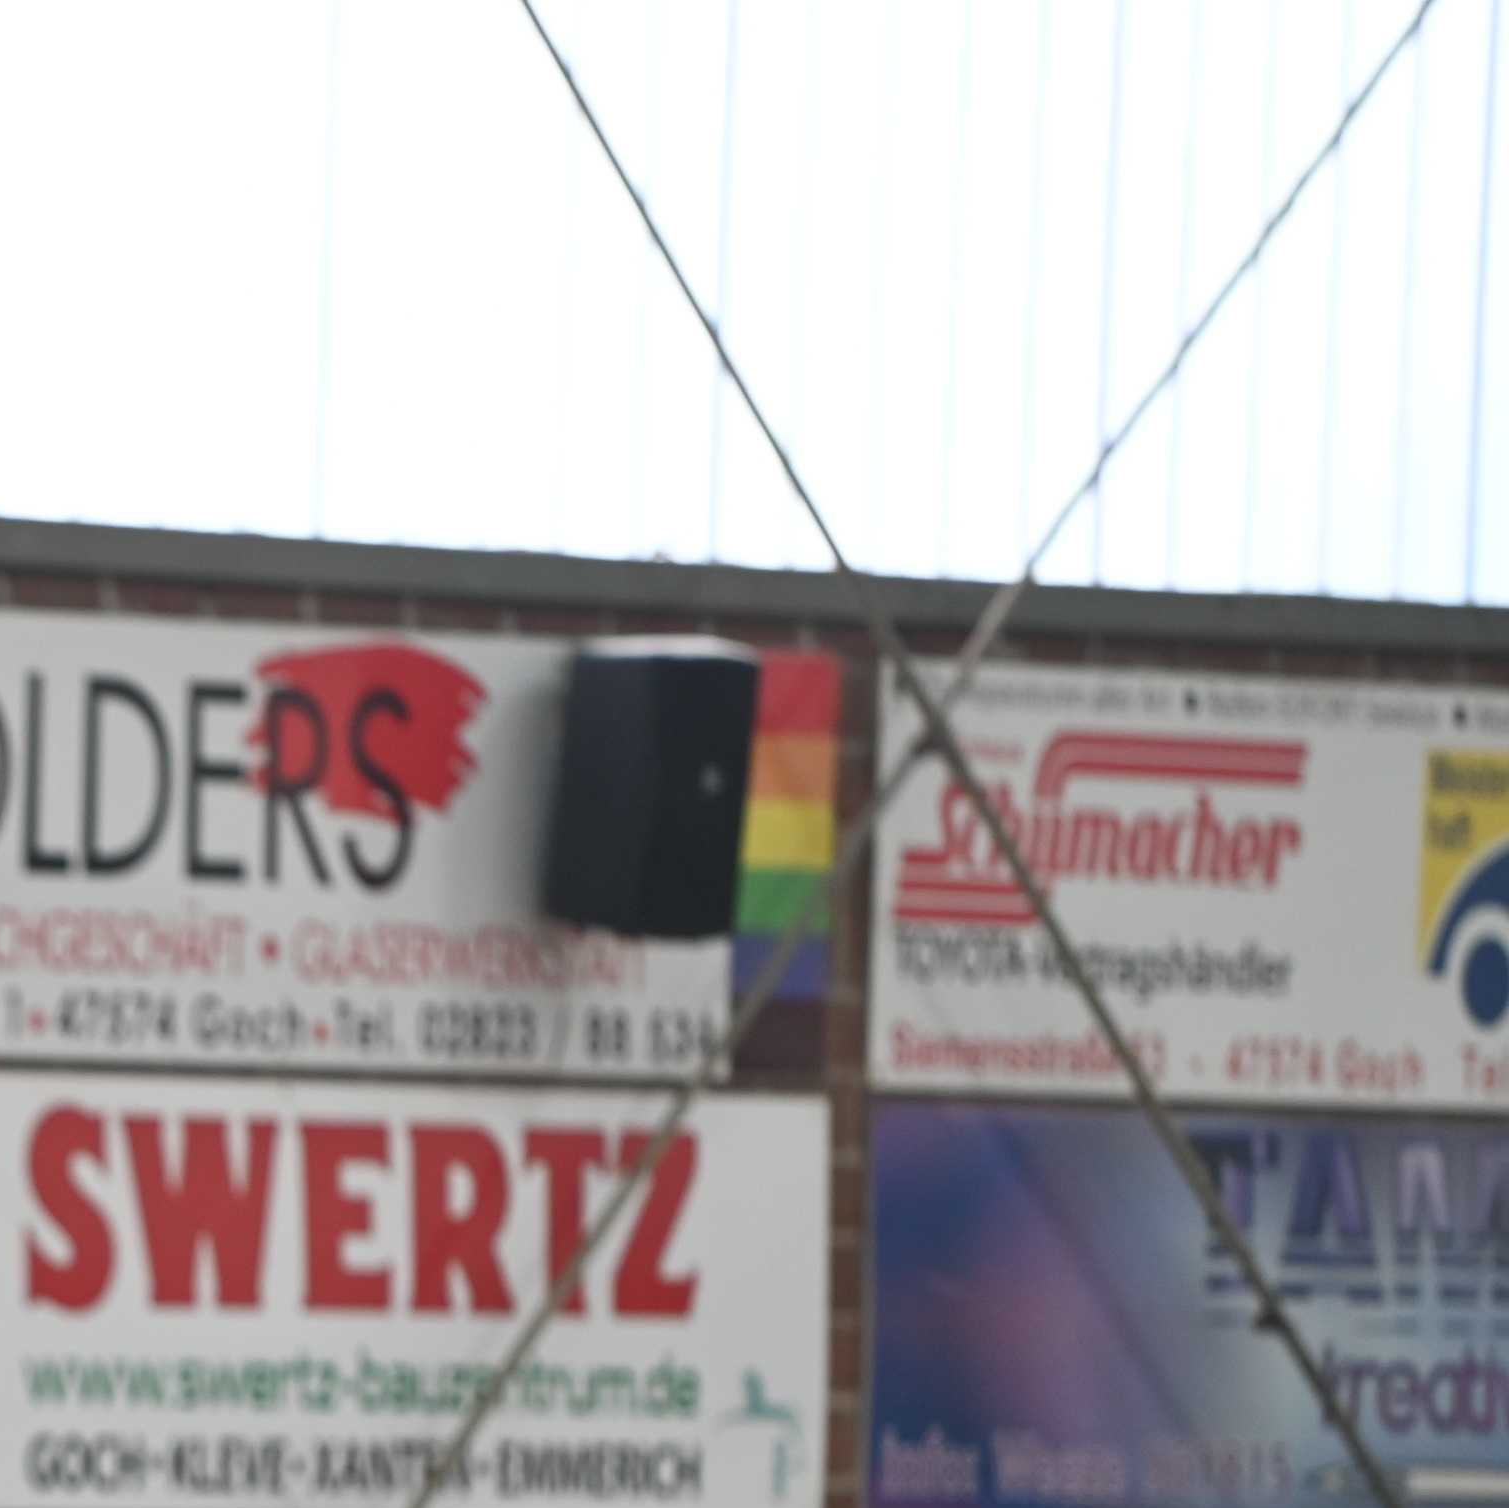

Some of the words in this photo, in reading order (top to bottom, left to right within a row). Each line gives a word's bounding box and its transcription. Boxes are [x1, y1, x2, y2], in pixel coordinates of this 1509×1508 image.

[190, 990, 307, 1051] Goch
[22, 1103, 700, 1320] SWERTZ
[24, 1434, 145, 1491] GOCH
[170, 1434, 285, 1494] KLEVE
[495, 1438, 703, 1500] EMMERICH
